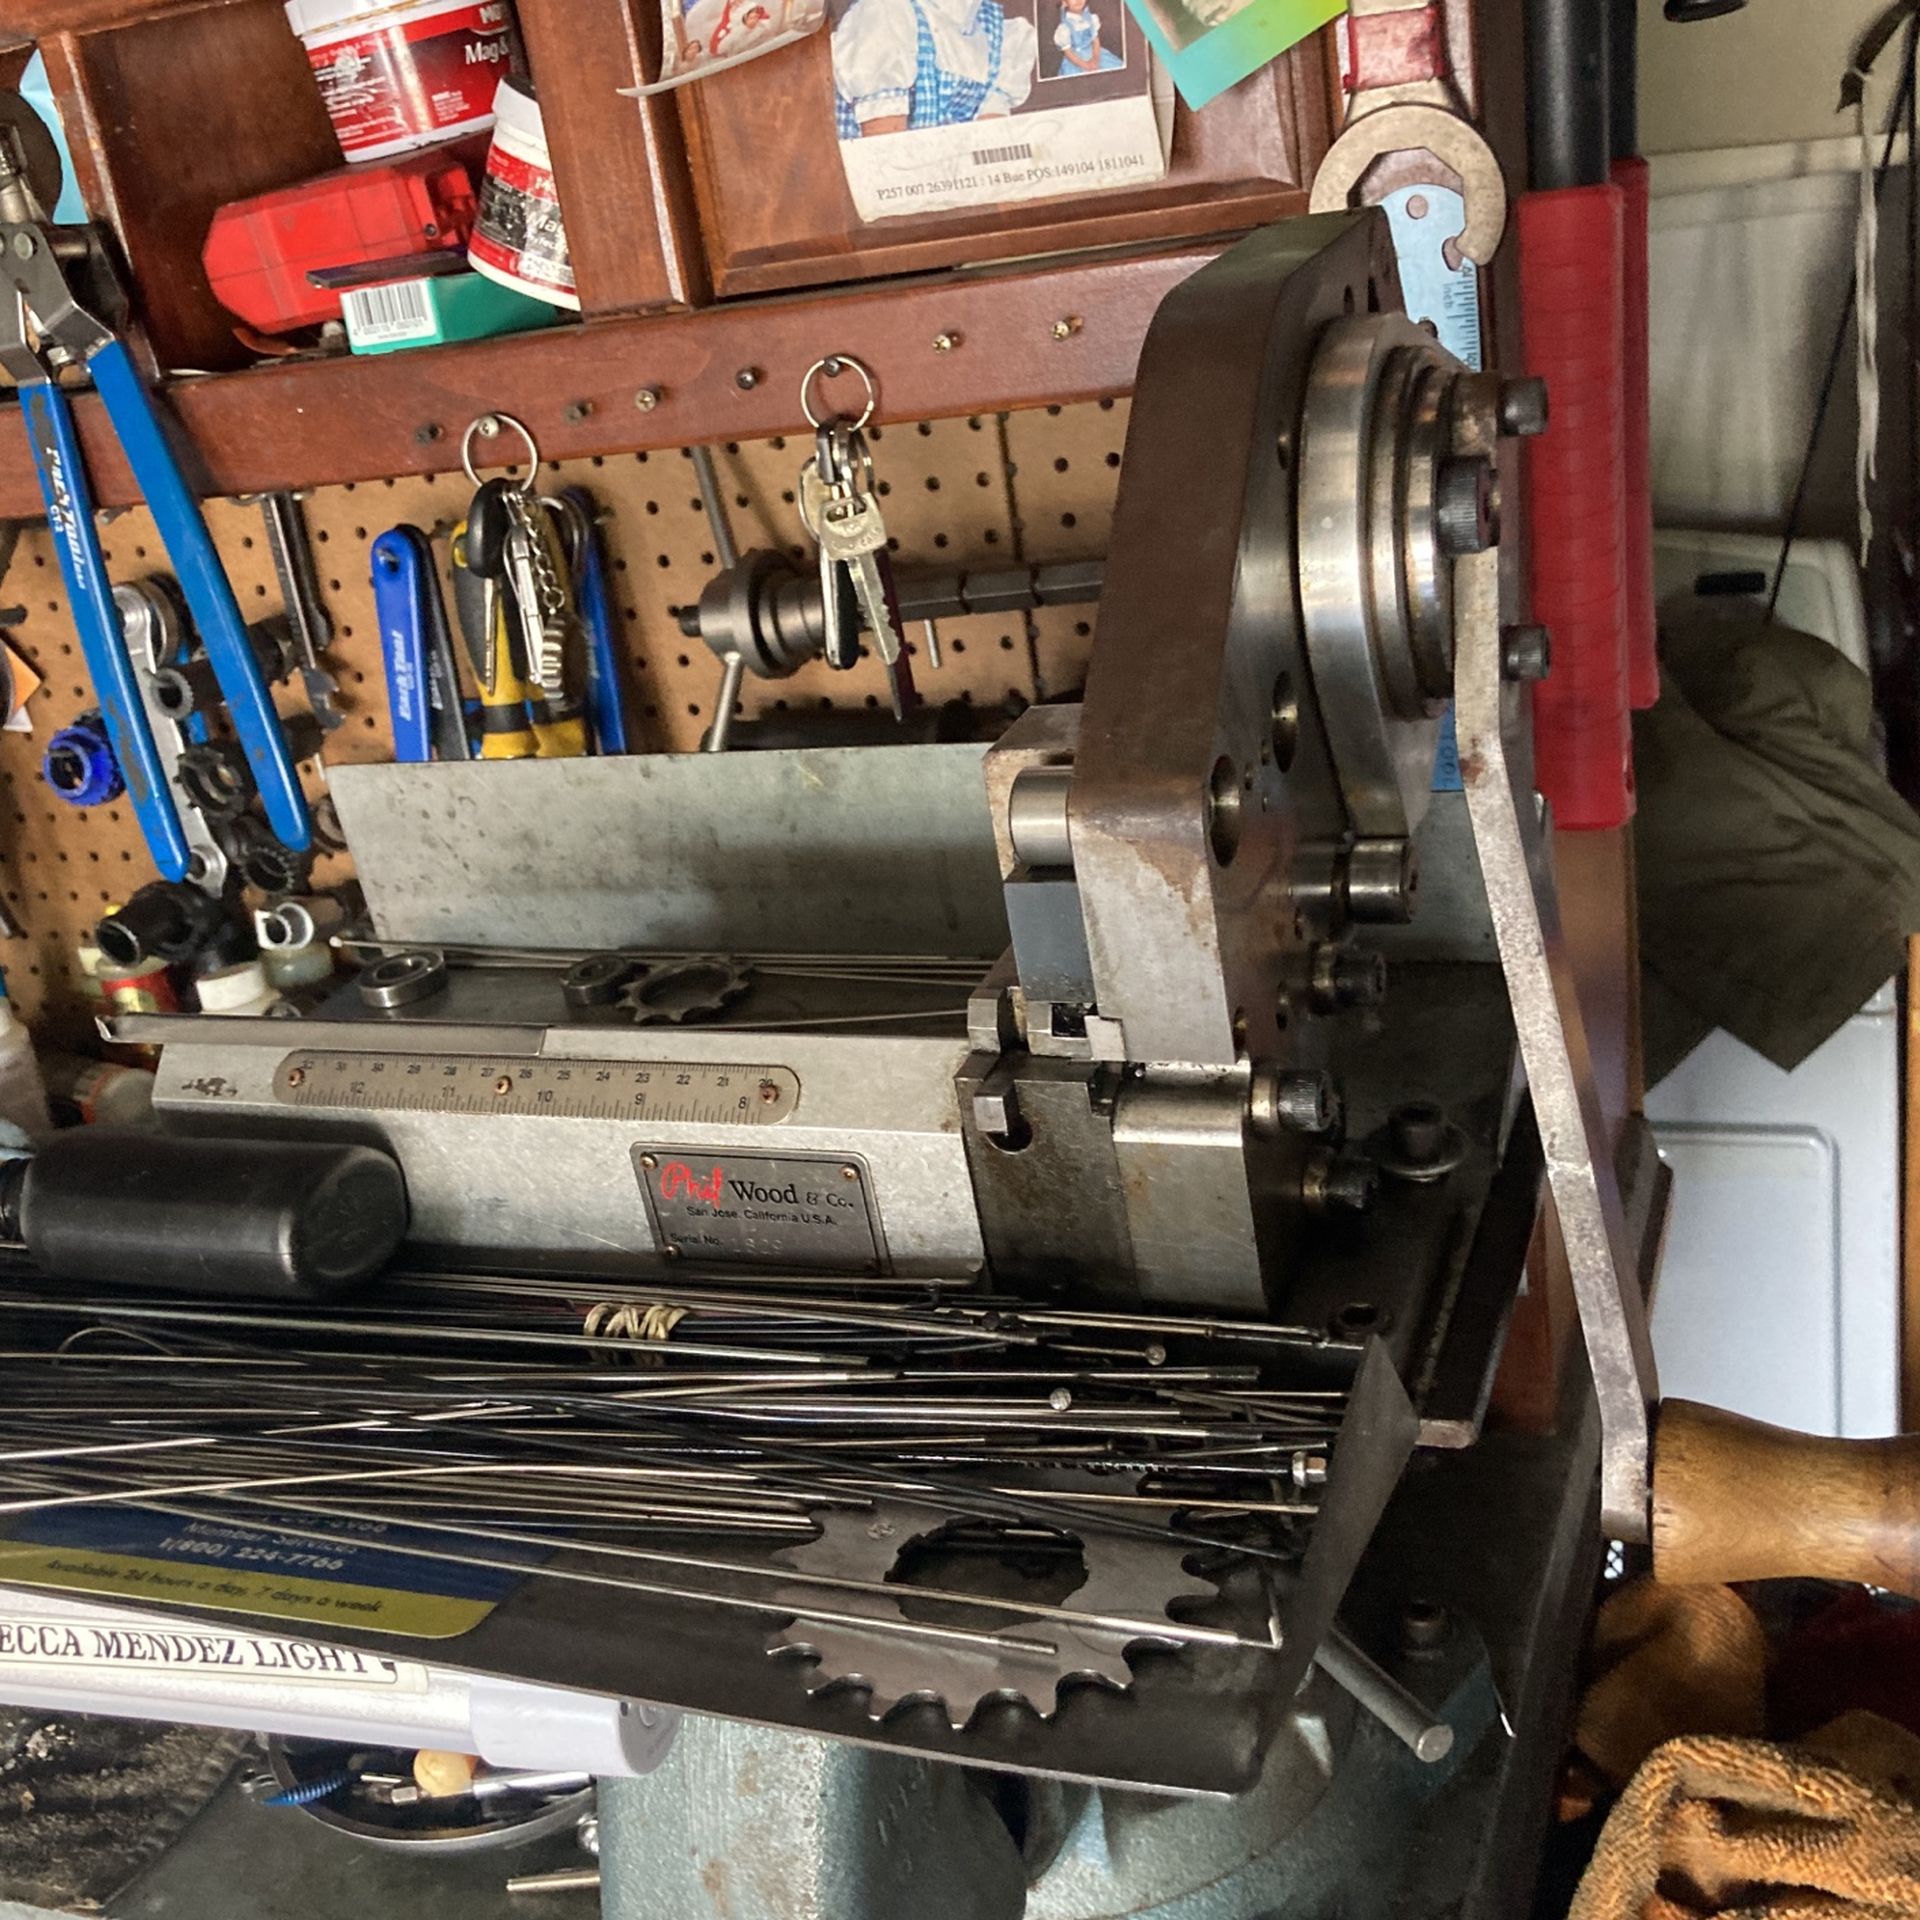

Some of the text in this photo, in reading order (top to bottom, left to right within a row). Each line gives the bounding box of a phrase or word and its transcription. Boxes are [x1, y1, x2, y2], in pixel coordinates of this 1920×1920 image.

[464, 41, 499, 65] Mag
[481, 1068, 495, 1078] 27
[519, 1069, 532, 1079] 26
[557, 1070, 570, 1080] 25
[596, 1071, 610, 1081] 24
[635, 1073, 650, 1083] 23
[676, 1074, 691, 1085] 22
[717, 1076, 729, 1087] 21
[538, 1091, 553, 1102] 10
[635, 1093, 643, 1105] 9
[738, 1097, 747, 1109] 8
[661, 1160, 854, 1208] Phil Wood & Co.
[686, 1206, 708, 1217] San
[744, 1210, 798, 1222] California
[0, 1624, 84, 1656] ECCA
[88, 1628, 245, 1666] MENDEZ
